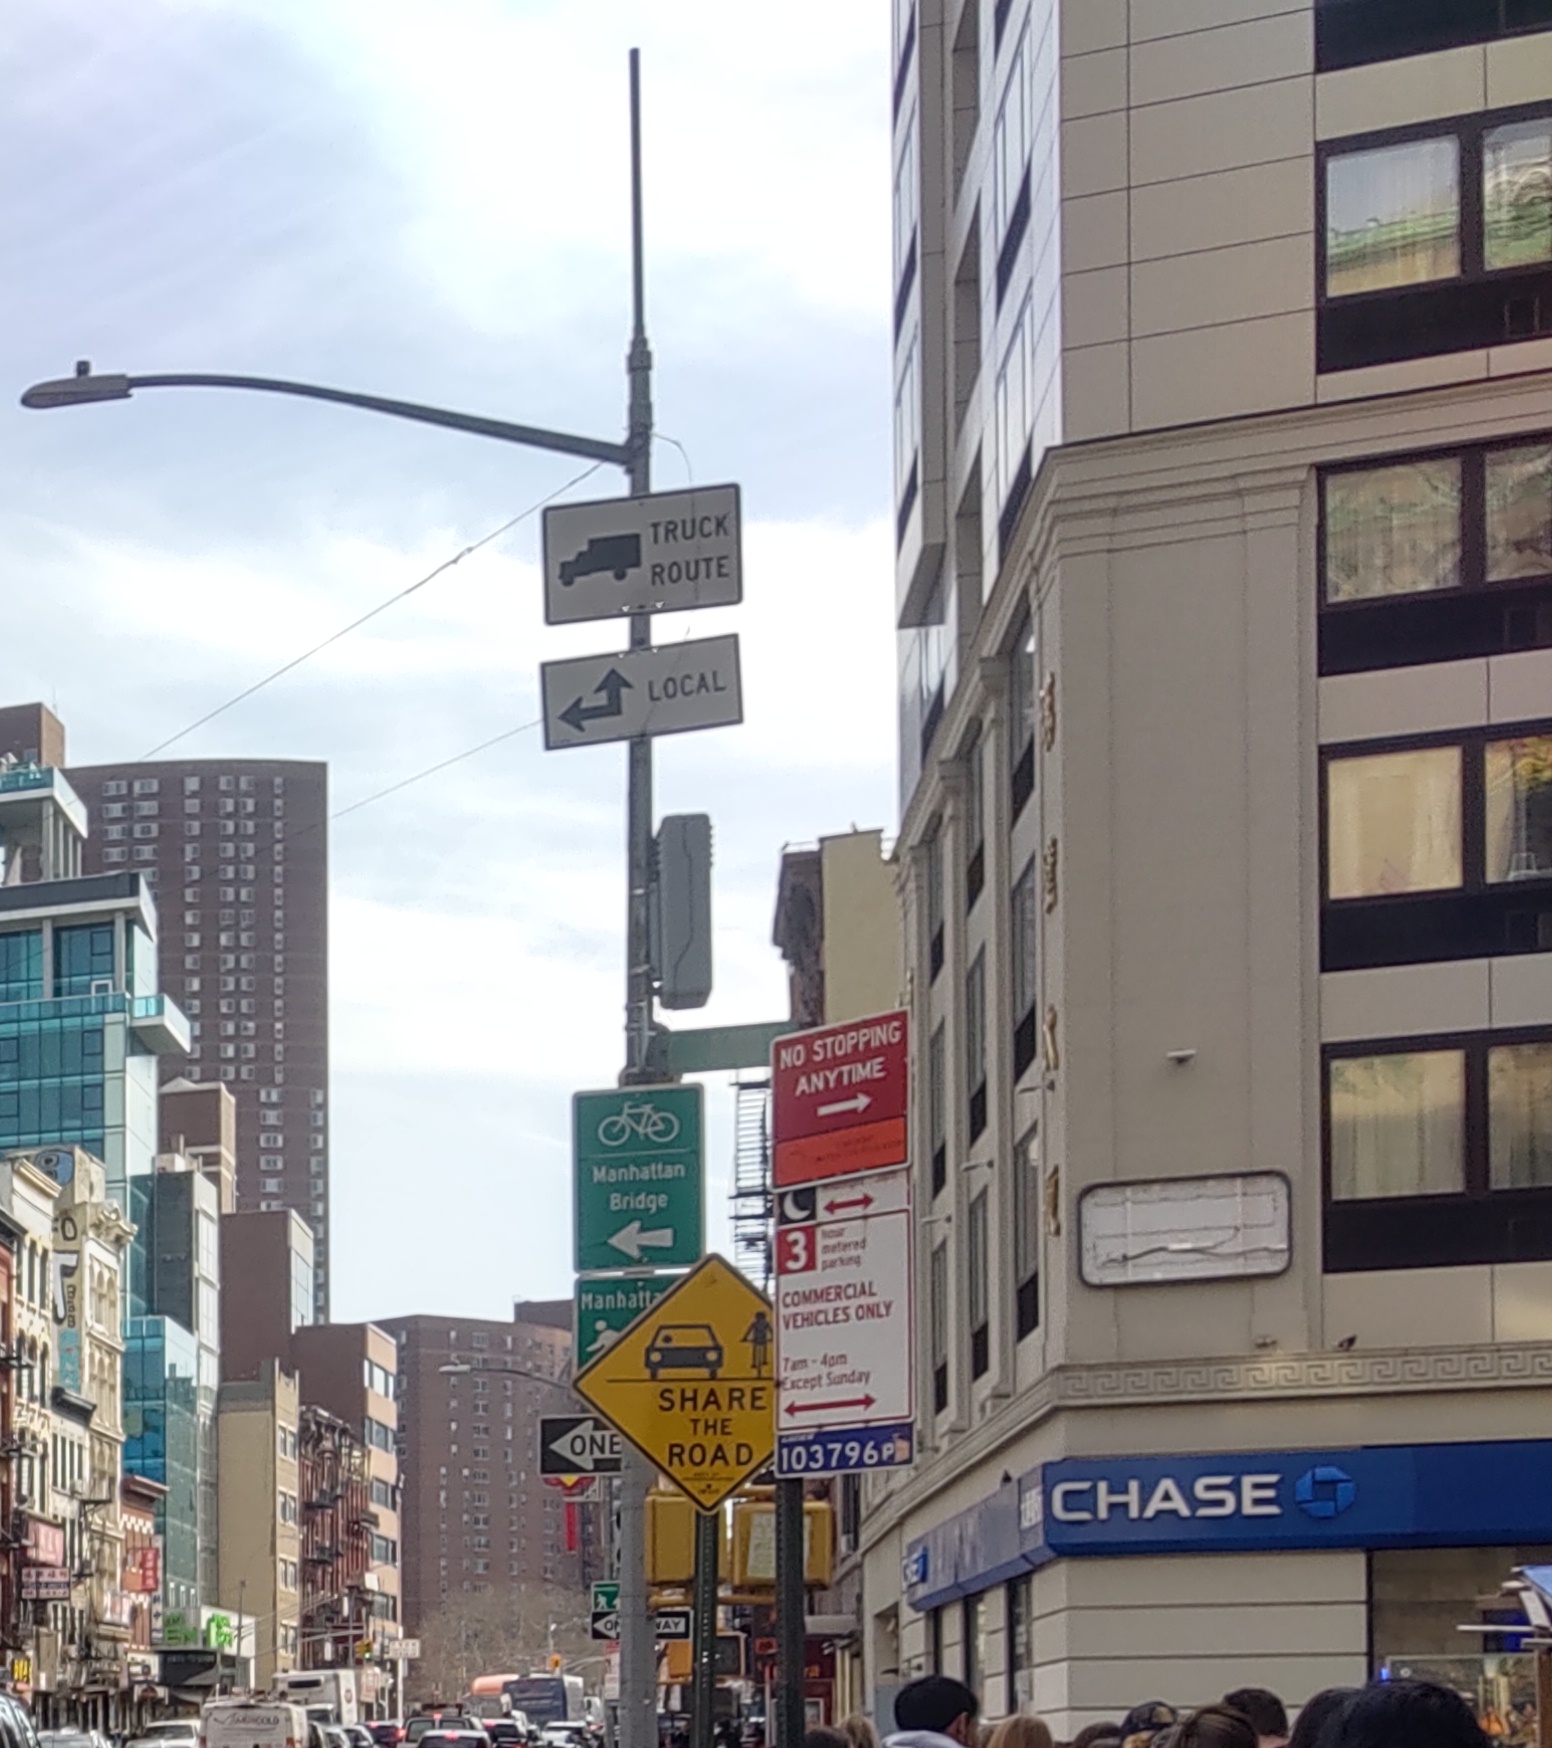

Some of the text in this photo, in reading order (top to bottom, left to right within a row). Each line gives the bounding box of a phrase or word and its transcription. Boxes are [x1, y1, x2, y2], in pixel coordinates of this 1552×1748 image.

[651, 513, 729, 544] TRUCK
[651, 556, 729, 586] ROUTE
[648, 671, 726, 701] LOCAL
[780, 1021, 902, 1069] NO STOPPING
[796, 1057, 887, 1097] ANYTIME
[593, 1163, 685, 1183] Manhattan
[610, 1192, 668, 1214] Bridge
[785, 1231, 806, 1271] 3
[821, 1238, 866, 1255] metered
[821, 1255, 861, 1271] parking
[581, 1291, 659, 1310] Manhatta
[782, 1281, 877, 1308] COMMERCIAL
[783, 1301, 893, 1330] VEHICLES ONLY
[783, 1357, 808, 1372] 7am
[782, 1370, 870, 1391] Except Sunday
[658, 1387, 767, 1412] SHARE
[690, 1418, 733, 1436] THE
[570, 1434, 621, 1456] ONE
[668, 1443, 753, 1467] ROAD
[1051, 1473, 1283, 1522] CHASE
